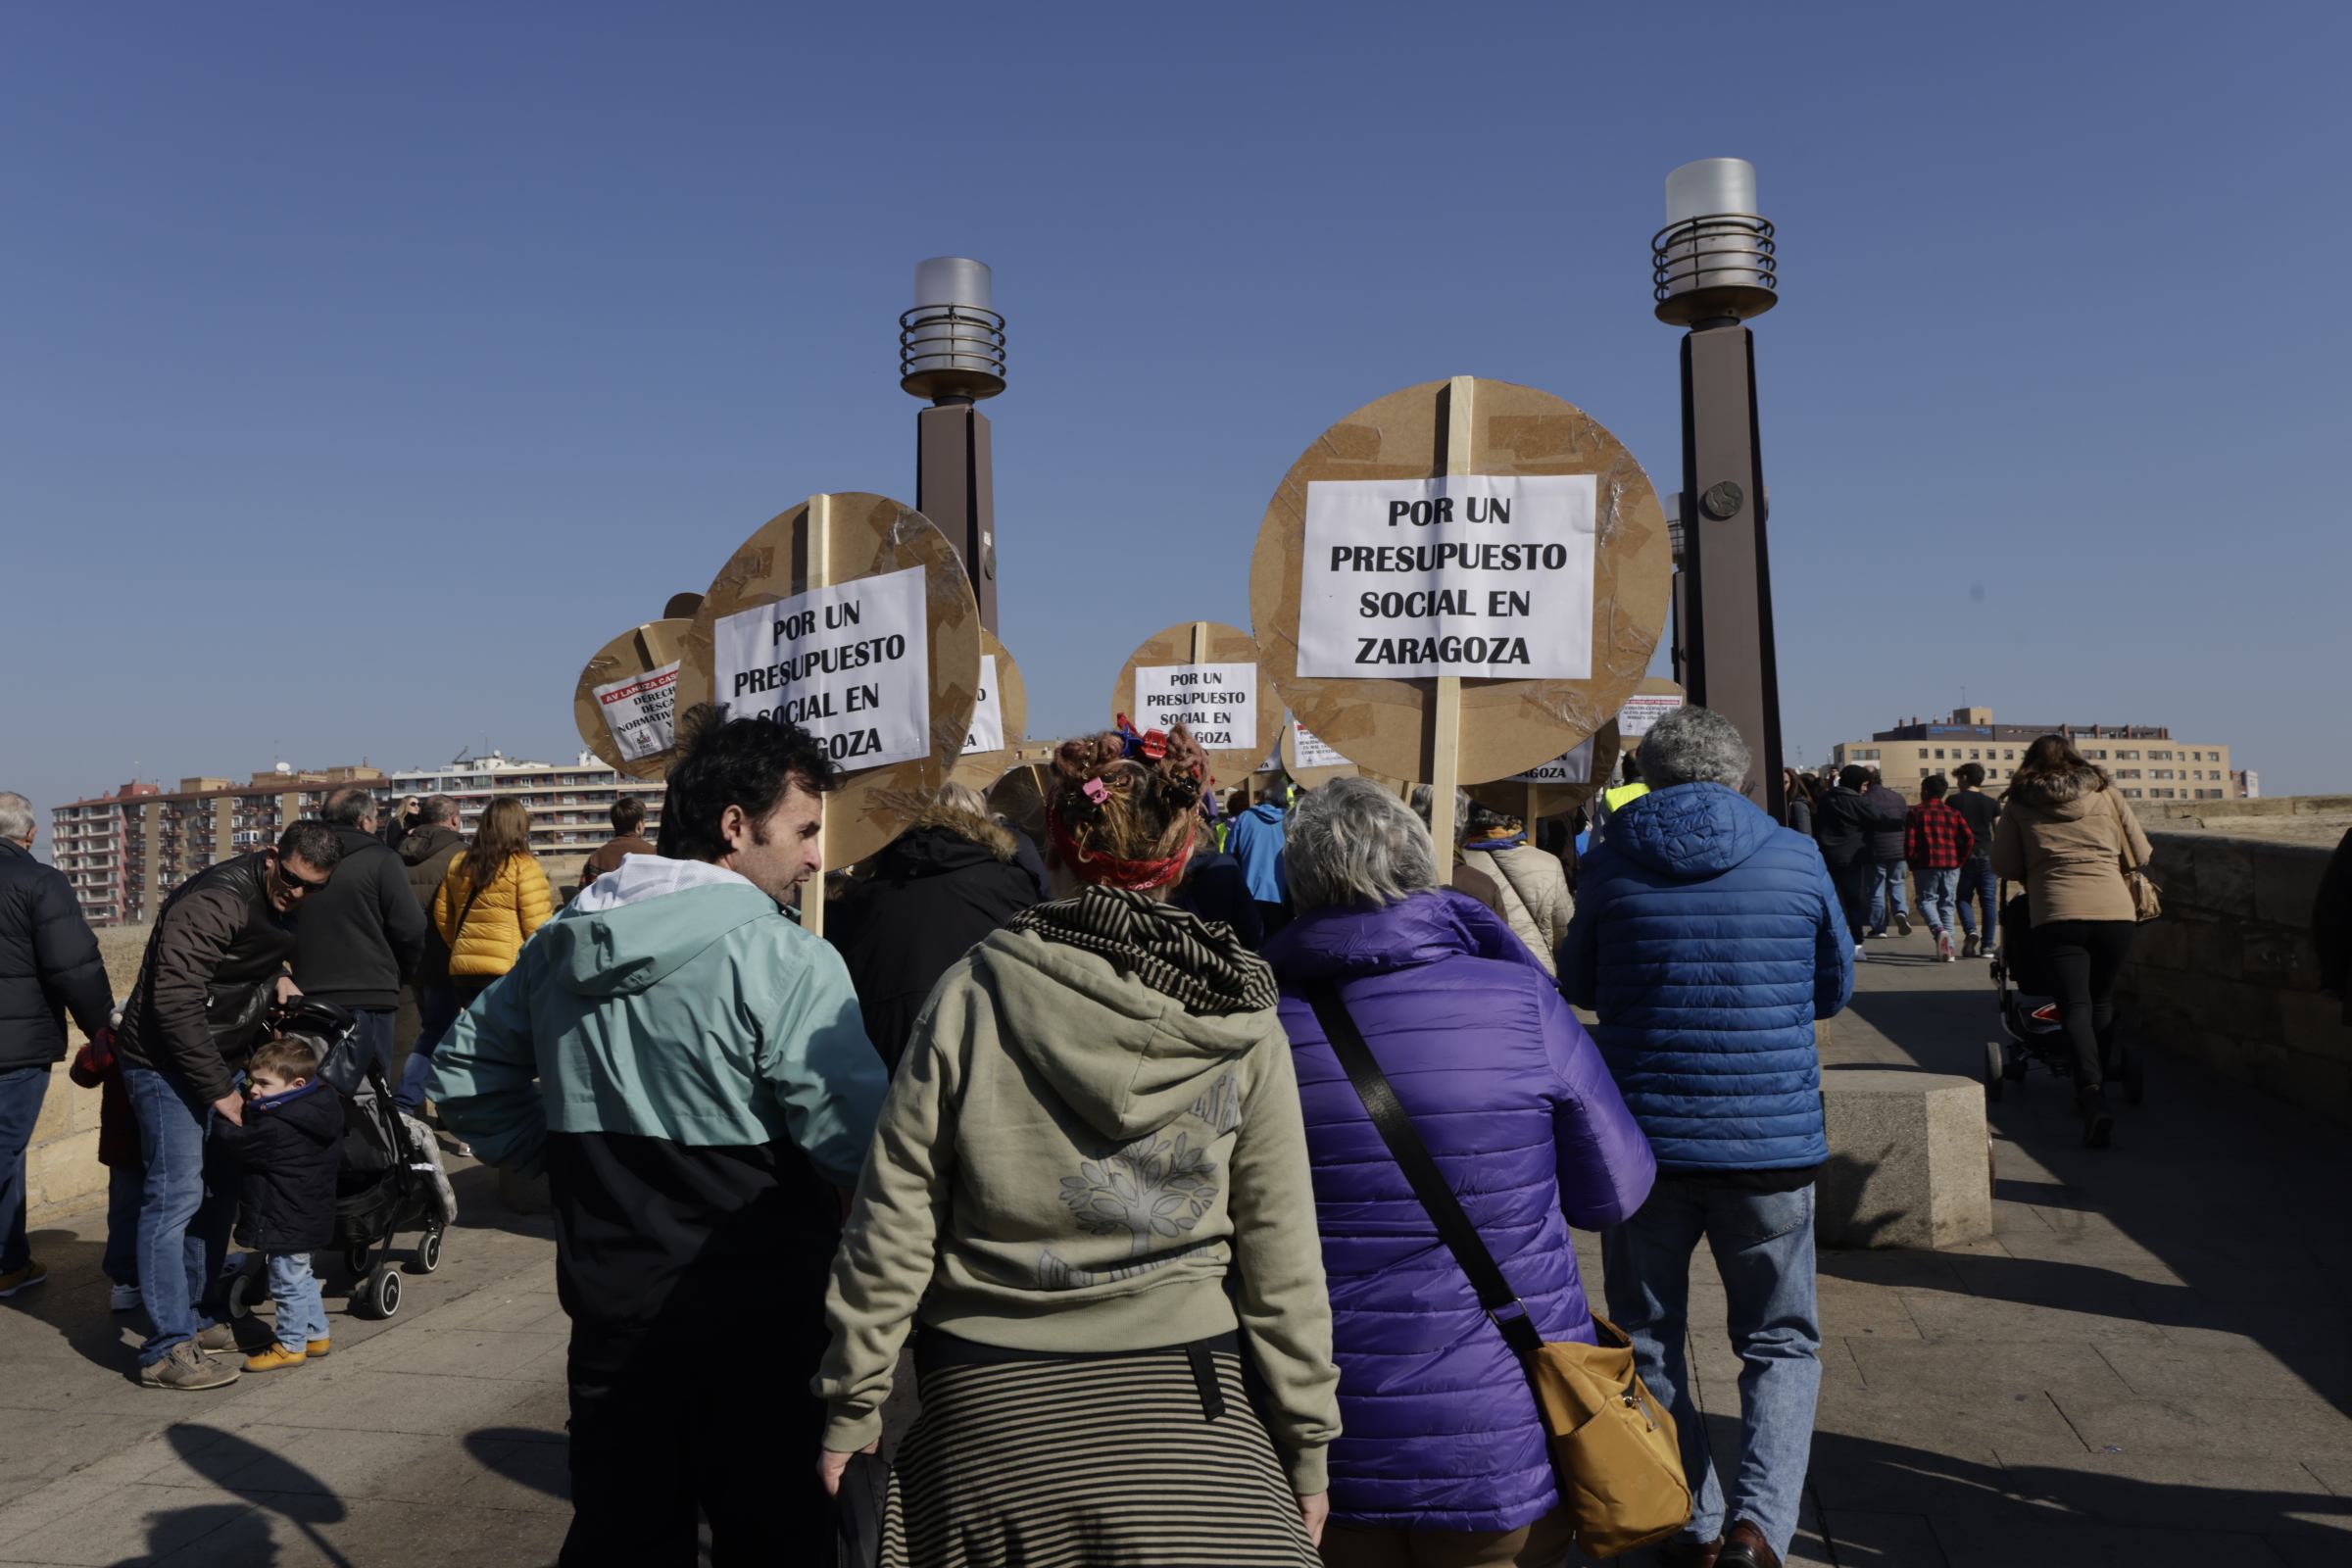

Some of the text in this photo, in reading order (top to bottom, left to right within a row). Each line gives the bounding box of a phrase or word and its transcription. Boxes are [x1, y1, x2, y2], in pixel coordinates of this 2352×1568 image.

[1388, 496, 1511, 526] POR UN
[1330, 542, 1567, 572] PRESUPUESTO
[1359, 589, 1531, 618] SOCIAL EN
[773, 599, 859, 646] POR UN
[1354, 635, 1531, 664] ZARAGOZA
[734, 633, 906, 698] PRESUPUESTO
[1170, 672, 1222, 686] POR UN
[606, 693, 618, 703] AV
[620, 681, 658, 698] LANUZA
[633, 686, 675, 706] DERECH
[641, 698, 675, 713] DESCA
[846, 682, 879, 713] EN
[1147, 691, 1246, 707] PRESUPUESTO
[1160, 711, 1231, 726] SOCIAL EN
[816, 727, 882, 760] GOZA
[1195, 731, 1232, 744] GOZA
